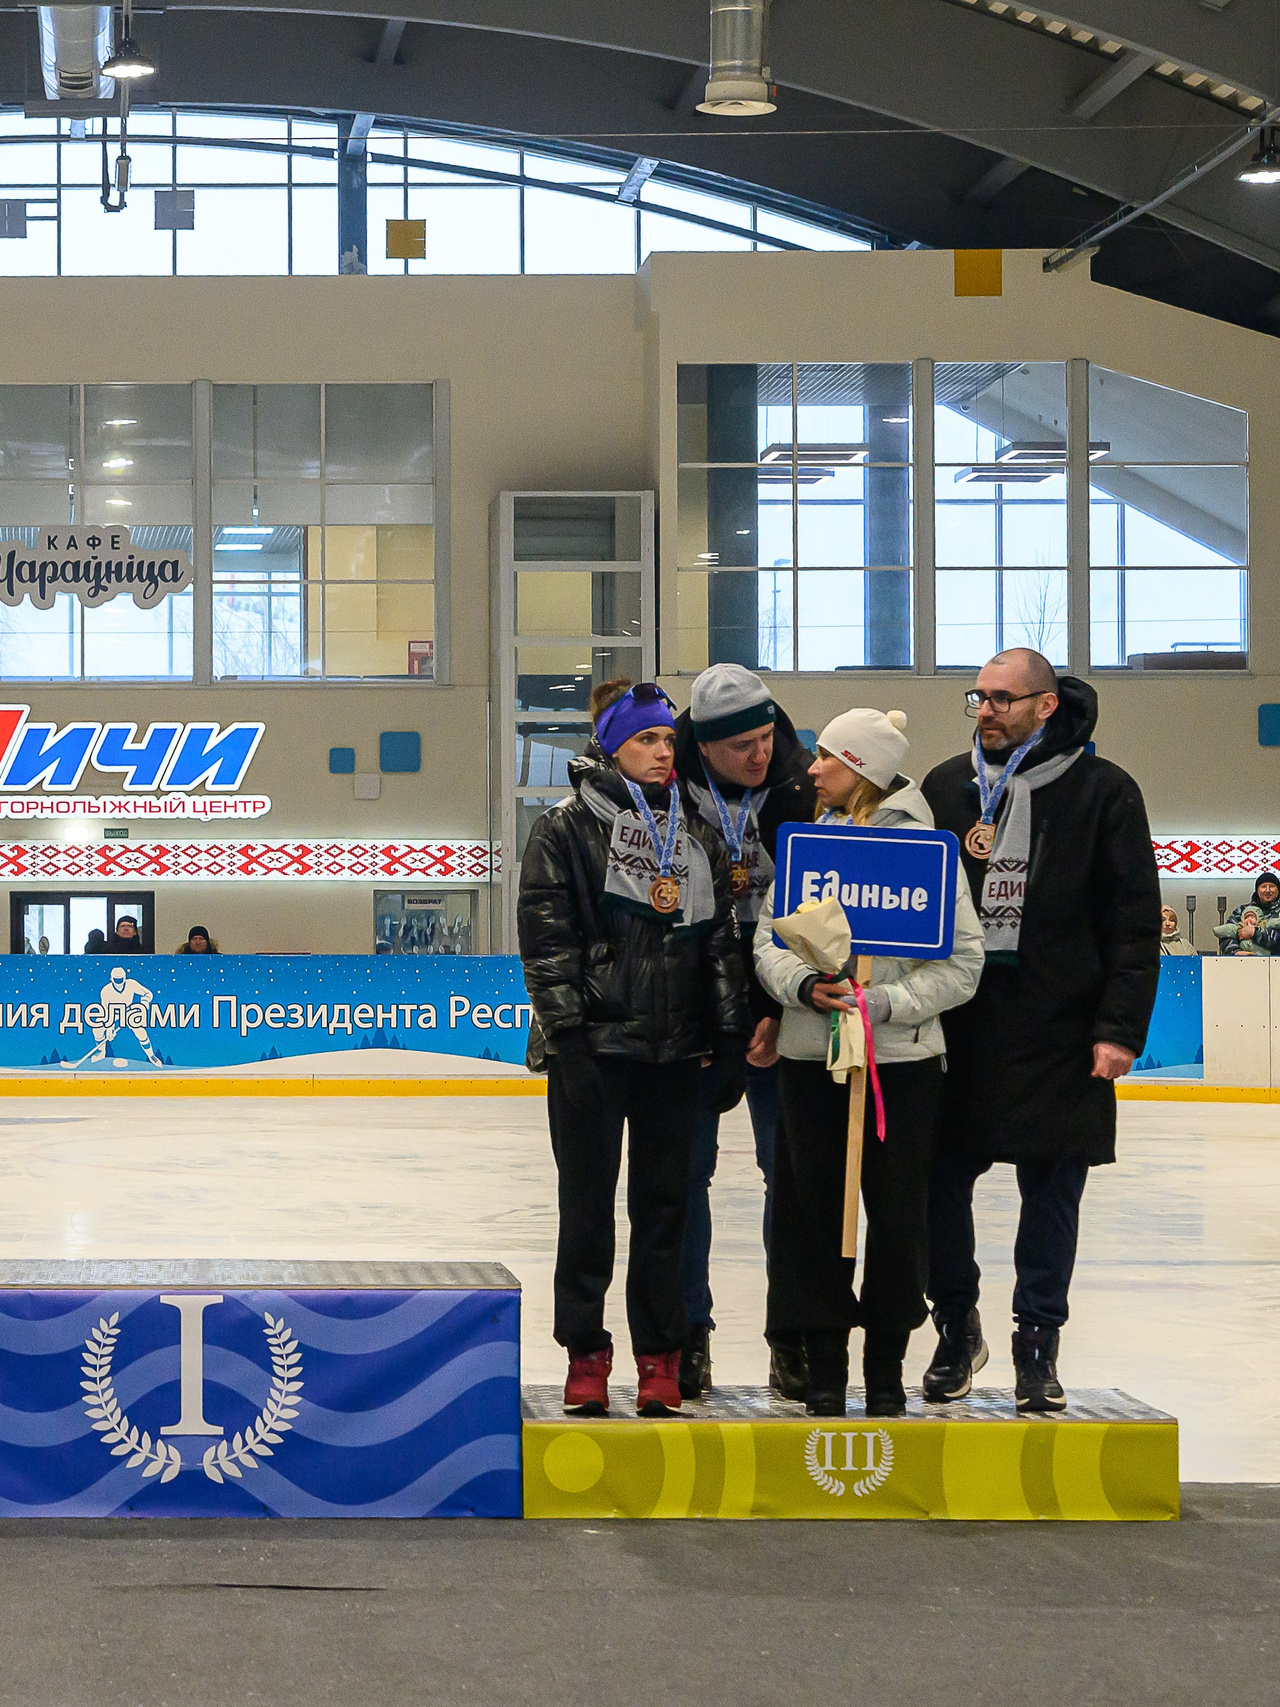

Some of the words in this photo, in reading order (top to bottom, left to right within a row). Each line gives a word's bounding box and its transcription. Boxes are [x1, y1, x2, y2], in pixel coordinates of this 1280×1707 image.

[47, 534, 121, 550] КАФЕ
[192, 800, 266, 816] ЦЕНТР
[801, 869, 929, 912] Единые
[988, 880, 1027, 901] ЕДИ
[59, 1002, 201, 1034] делами
[212, 995, 438, 1037] Президента
[448, 995, 534, 1029] Респ
[819, 1432, 879, 1471] III
